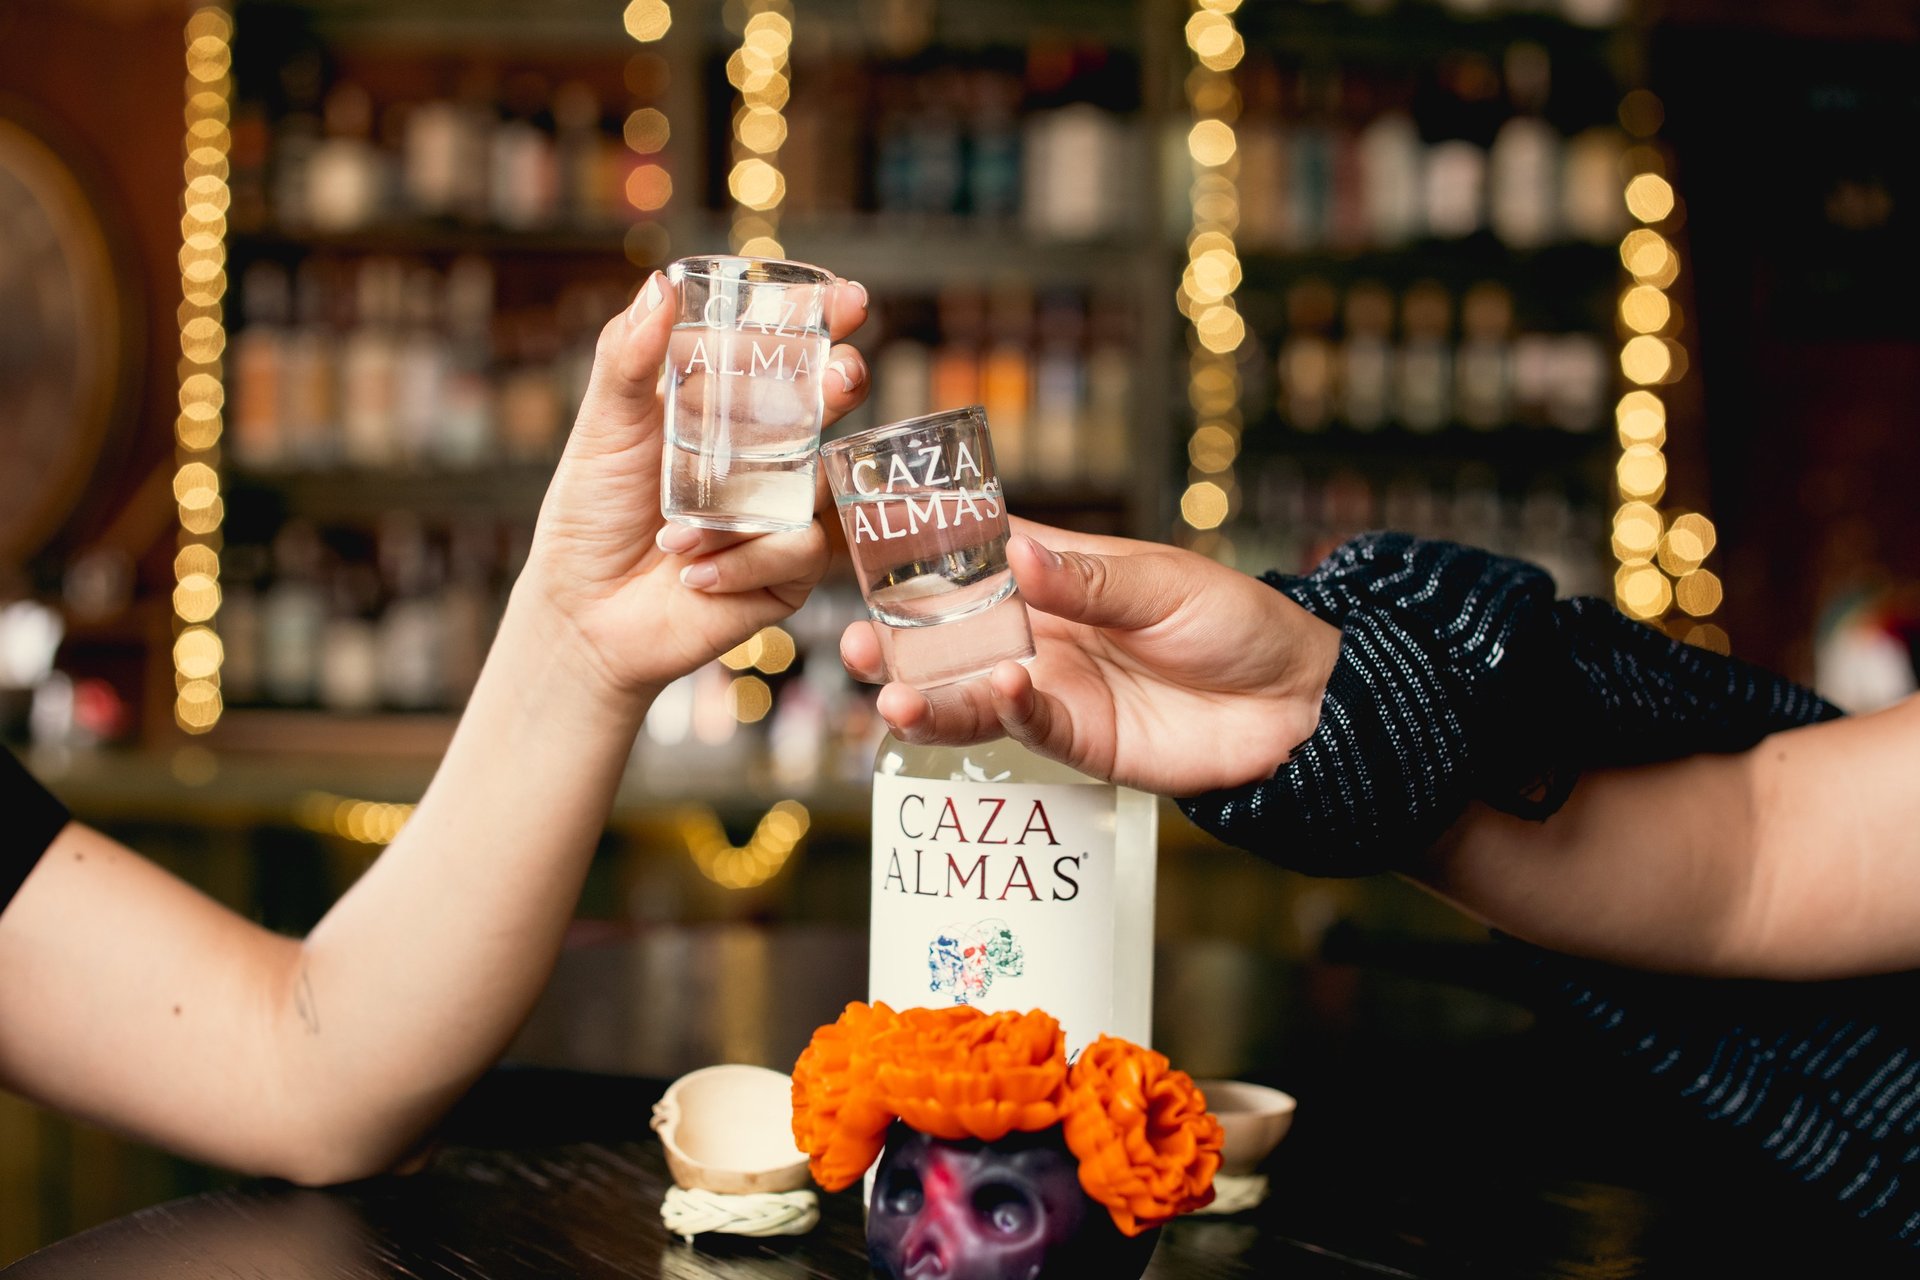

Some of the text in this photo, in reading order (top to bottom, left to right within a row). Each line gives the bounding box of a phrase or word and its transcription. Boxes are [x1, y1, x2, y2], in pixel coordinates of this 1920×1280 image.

[684, 336, 812, 383] ALMA
[851, 441, 982, 497] CAZA
[899, 794, 1061, 846] CAZA
